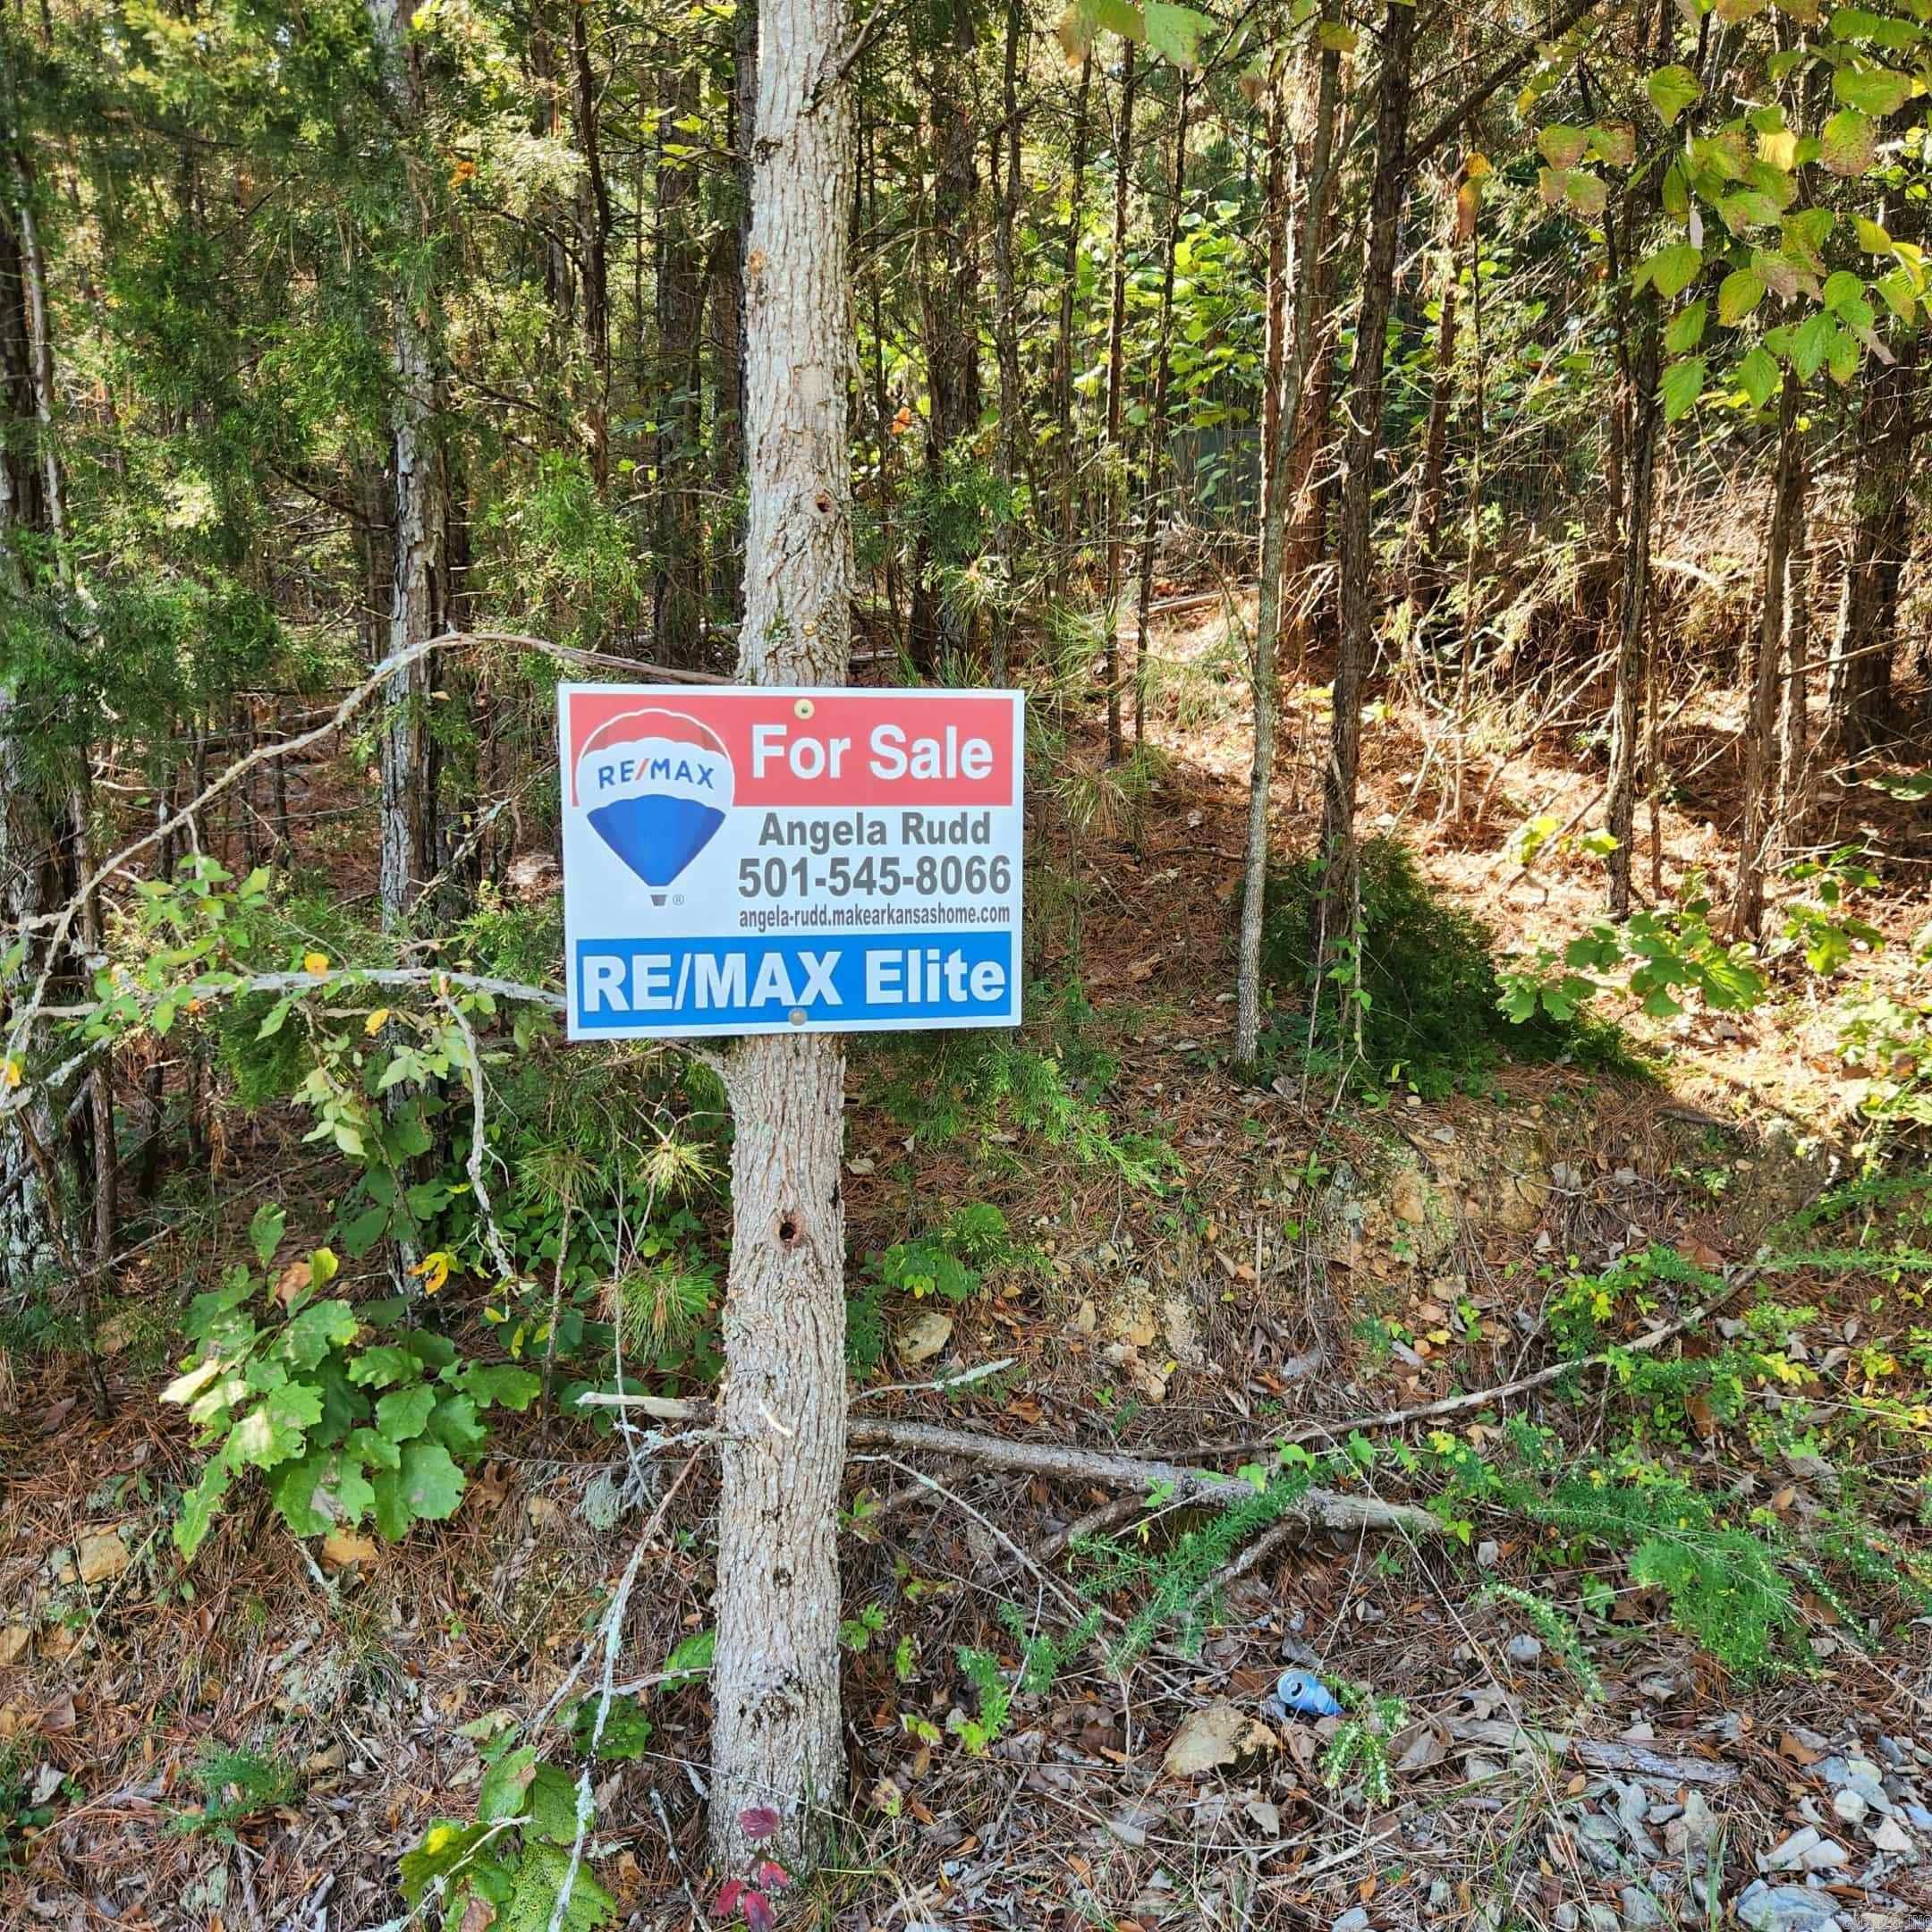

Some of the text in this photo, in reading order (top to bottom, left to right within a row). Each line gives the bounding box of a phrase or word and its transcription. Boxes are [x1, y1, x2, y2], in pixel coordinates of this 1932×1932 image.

[597, 757, 715, 790] RE/MAX
[751, 724, 993, 781] For Sale
[758, 811, 991, 853] Angela Rudd
[738, 855, 1012, 897] 501-545-8066
[739, 903, 1010, 932] angela-rudd.makearkansashome.com
[582, 948, 1006, 1013] RE/MAX Elite
